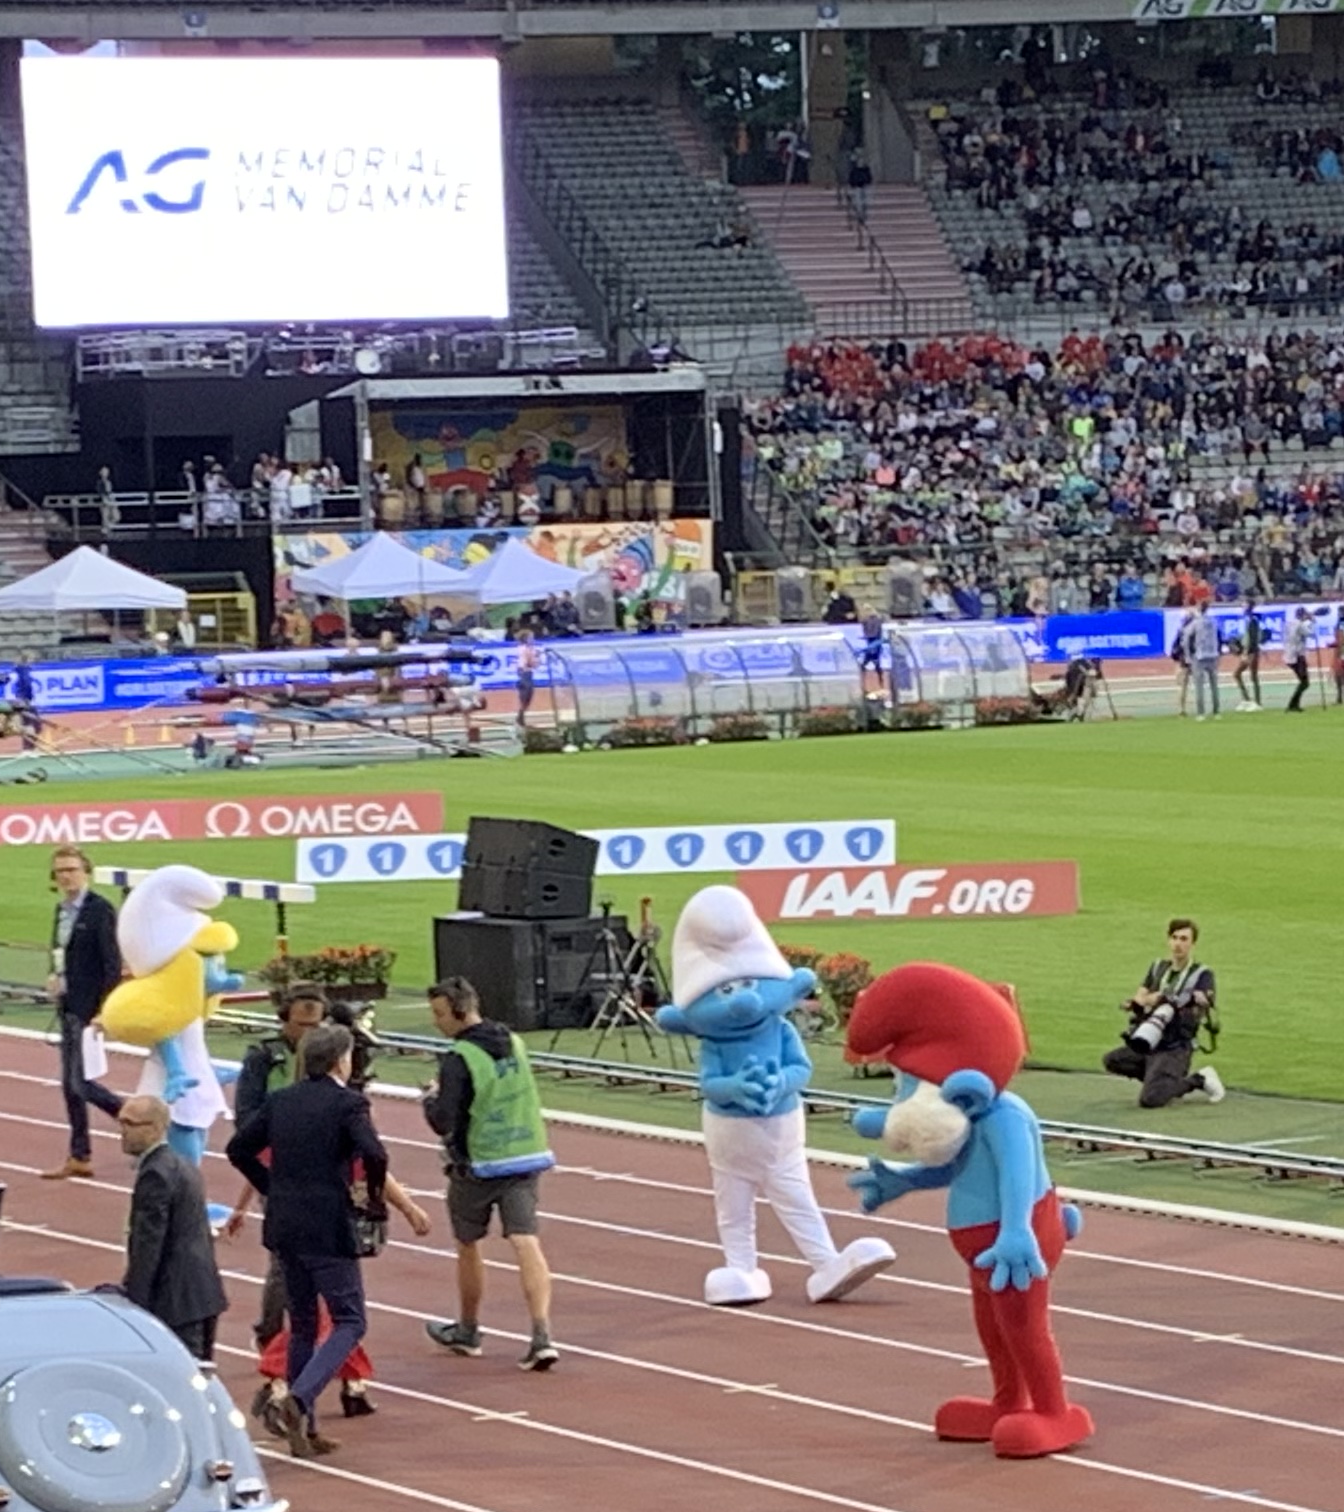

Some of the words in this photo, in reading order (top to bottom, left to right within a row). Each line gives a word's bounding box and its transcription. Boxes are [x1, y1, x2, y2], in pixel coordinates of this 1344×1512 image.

[236, 147, 446, 178] MEMORIAL
[64, 147, 210, 214] AG
[236, 183, 306, 213] VAN
[328, 182, 471, 213] DAMME
[46, 675, 99, 692] PLAN
[0, 811, 172, 844] OMEGA
[261, 802, 419, 837] OMEGA
[317, 848, 335, 872] 1
[376, 847, 393, 871] 1
[434, 845, 453, 869] 1
[615, 839, 632, 864] 1
[674, 837, 692, 862] 1
[733, 835, 751, 860] 1
[794, 833, 811, 858] 1
[852, 831, 870, 856] 1
[778, 868, 1035, 919] IAAF.ORG
